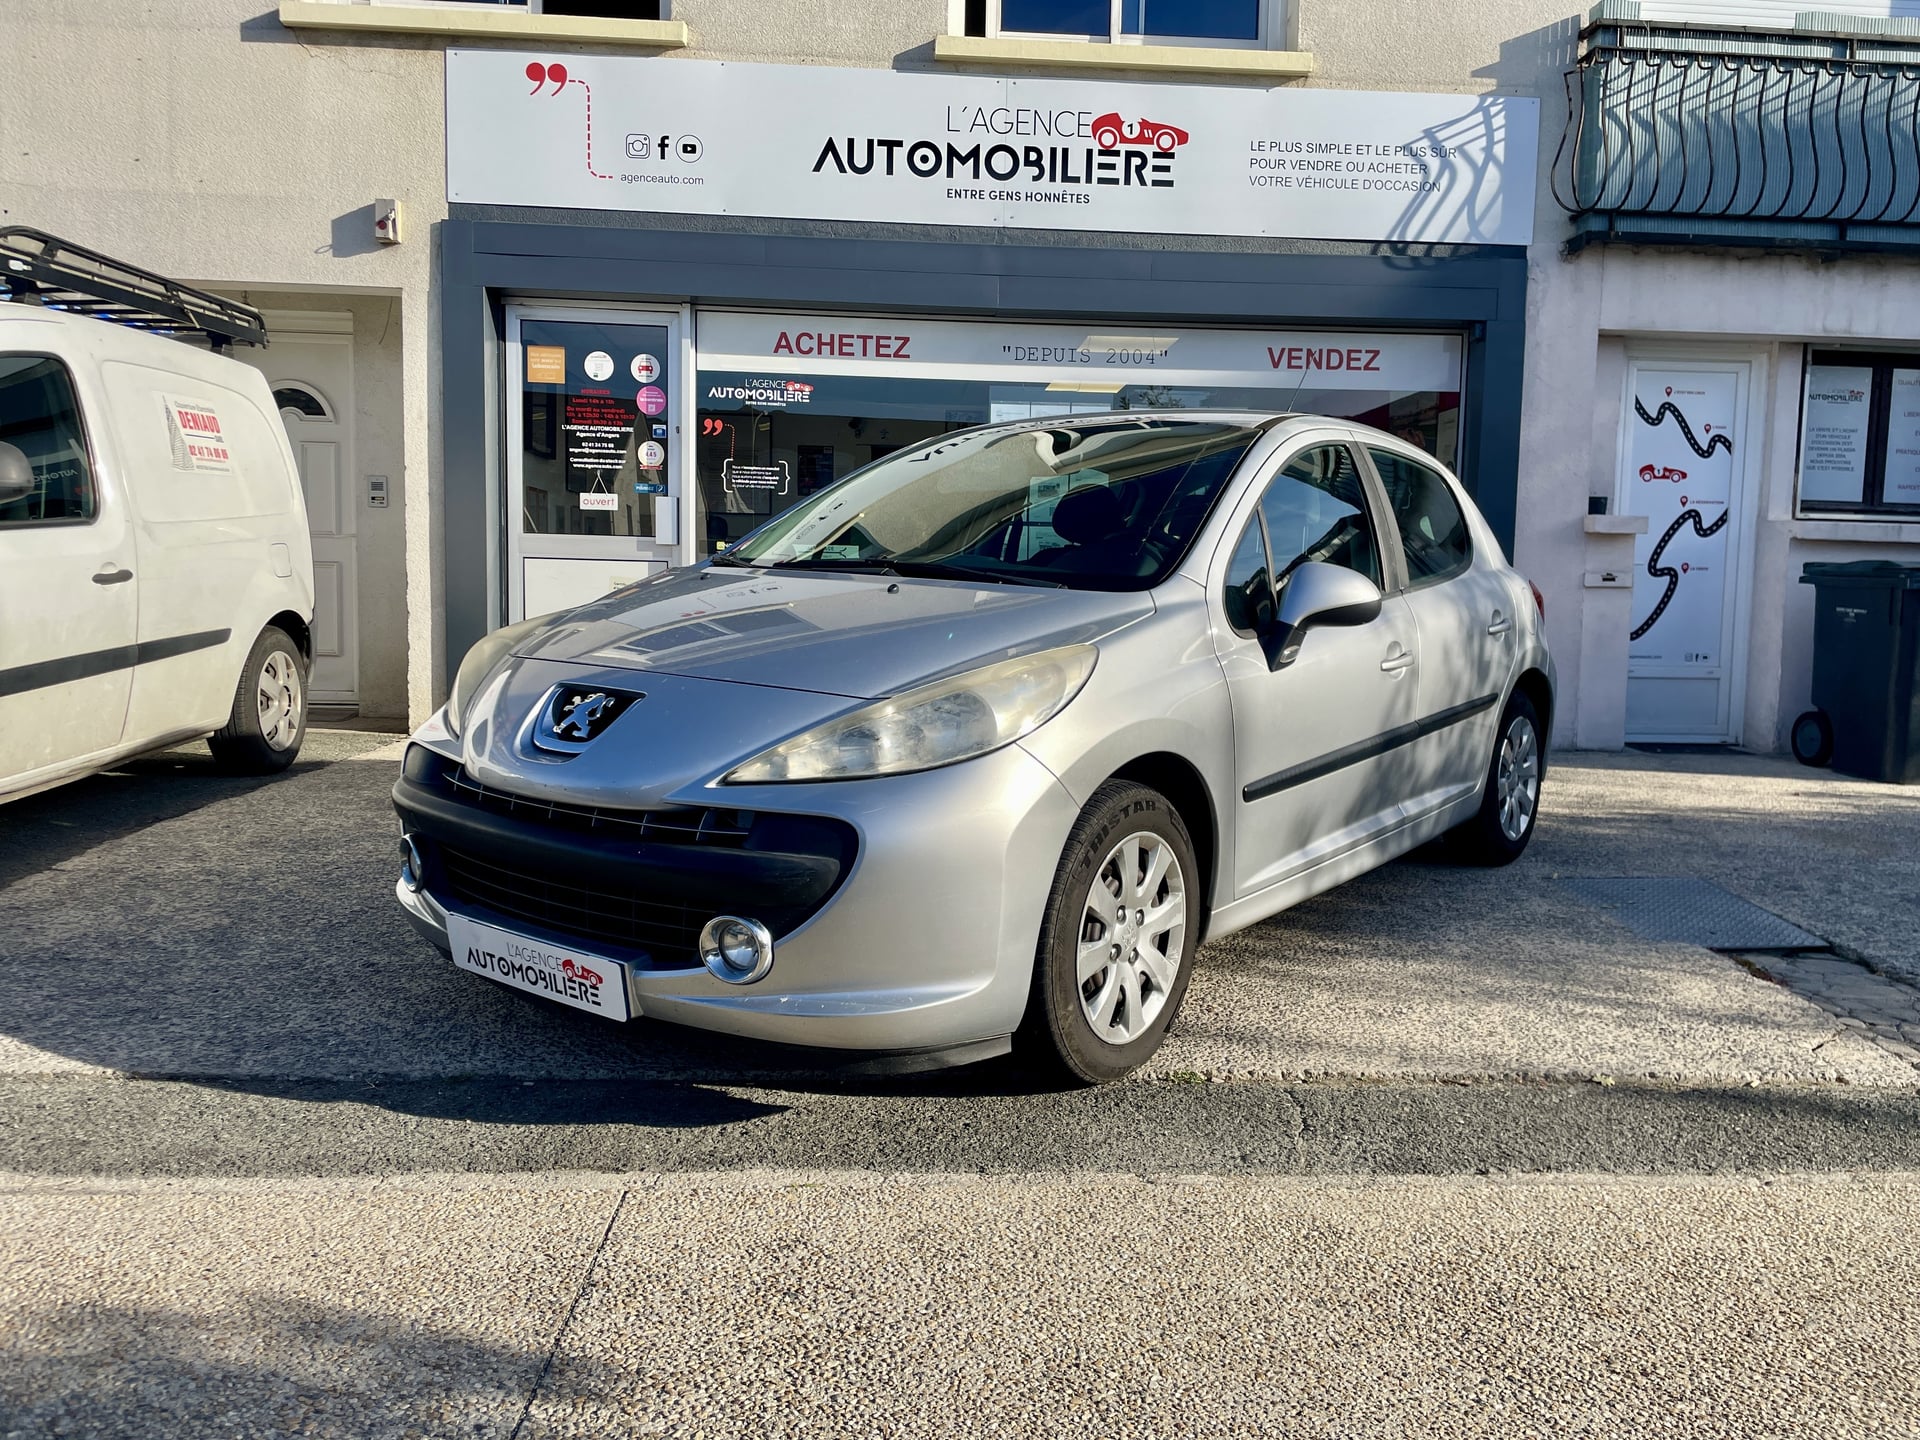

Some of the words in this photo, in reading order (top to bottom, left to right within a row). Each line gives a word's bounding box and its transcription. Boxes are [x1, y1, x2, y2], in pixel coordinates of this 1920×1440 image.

[946, 105, 1092, 138] L'AGENCE
[1250, 140, 1266, 152] LE
[1269, 141, 1303, 153] PLUS
[1305, 142, 1353, 155] SIMPLE
[1356, 144, 1372, 155] ET
[1375, 145, 1391, 156] LE
[1394, 146, 1427, 157] PLUS
[1430, 145, 1457, 159] SÛR
[1249, 157, 1286, 170] POUR
[1289, 159, 1343, 172] VENDRE
[1345, 161, 1365, 173] OU
[1367, 162, 1428, 175] ACHETER
[620, 173, 704, 185] agenceauto.com
[1249, 175, 1293, 188] VOTRE
[1296, 175, 1359, 190] VÉHICULE
[1362, 179, 1441, 192] D'OCCASION
[946, 188, 985, 200] ENTRE
[988, 190, 1022, 201] GENS
[1025, 190, 1090, 204] HONNÊTES
[772, 331, 911, 359] ACHETEZ
[1266, 346, 1381, 372] VENDEZ
[745, 378, 787, 389] L'AGENCE
[177, 410, 221, 434] DENIAUD
[582, 497, 615, 506] ouvert
[506, 941, 563, 973] L'AGENCE
